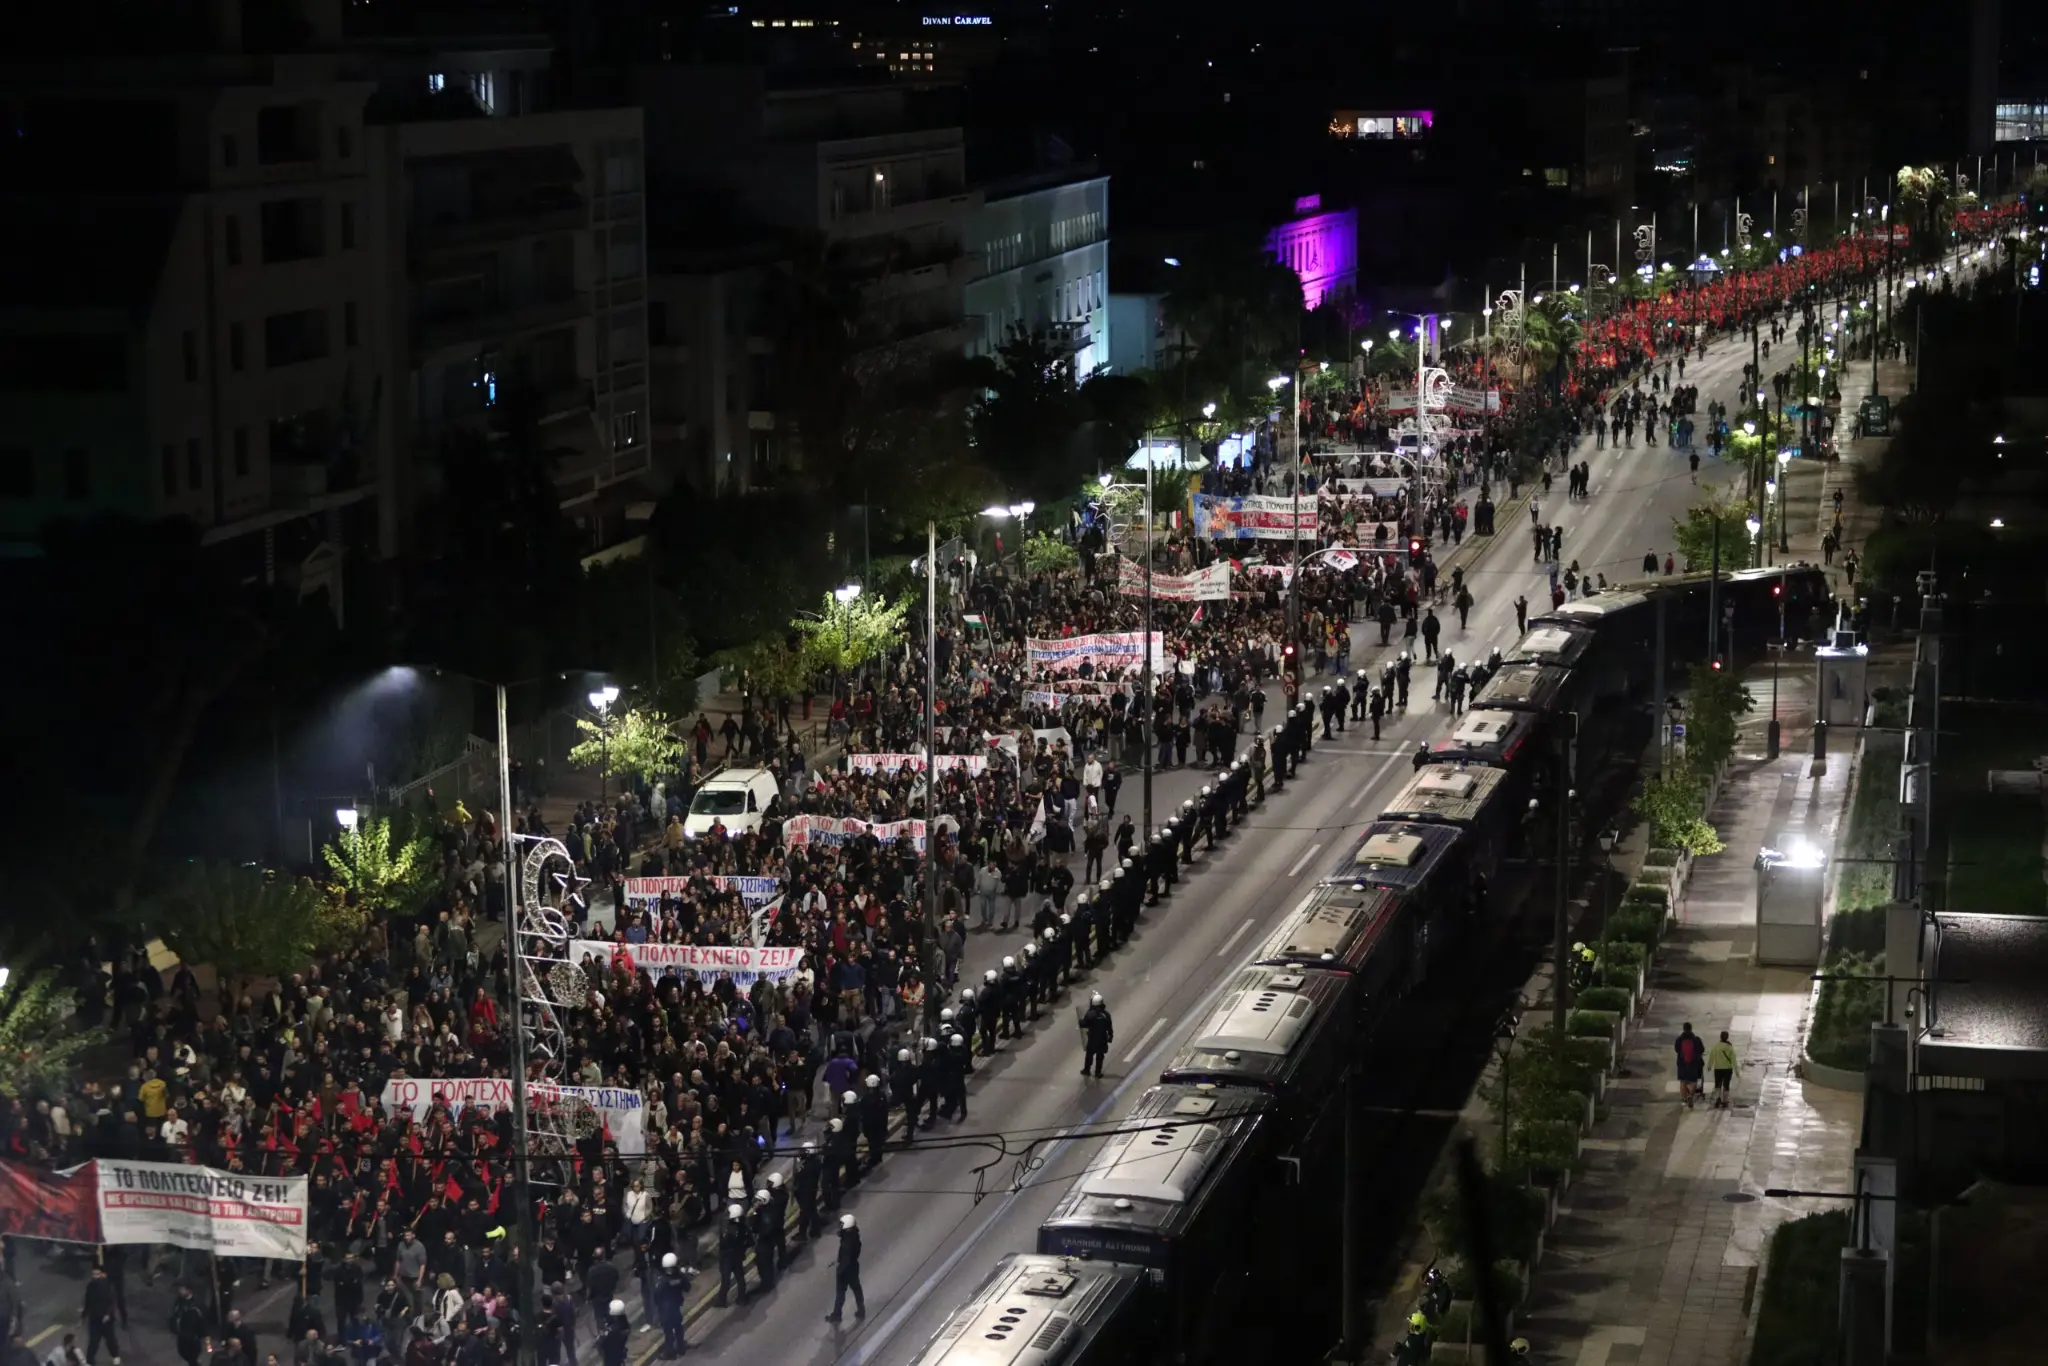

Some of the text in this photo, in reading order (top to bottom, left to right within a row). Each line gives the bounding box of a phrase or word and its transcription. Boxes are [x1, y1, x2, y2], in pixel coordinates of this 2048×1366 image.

[954, 16, 992, 25] CARAVEL
[639, 945, 750, 966] ΠΟΛΥΤΕΧΝΕΙΟ
[760, 948, 796, 966] ΖΕΙ!
[391, 1081, 418, 1102] ΤΟ
[589, 1088, 641, 1109] ΣΥΣΤΗΜΑ
[113, 1167, 289, 1203] ΤΟ ΠΟΛΥΤΕΧΝΕΙΟ ΖΕΙ!
